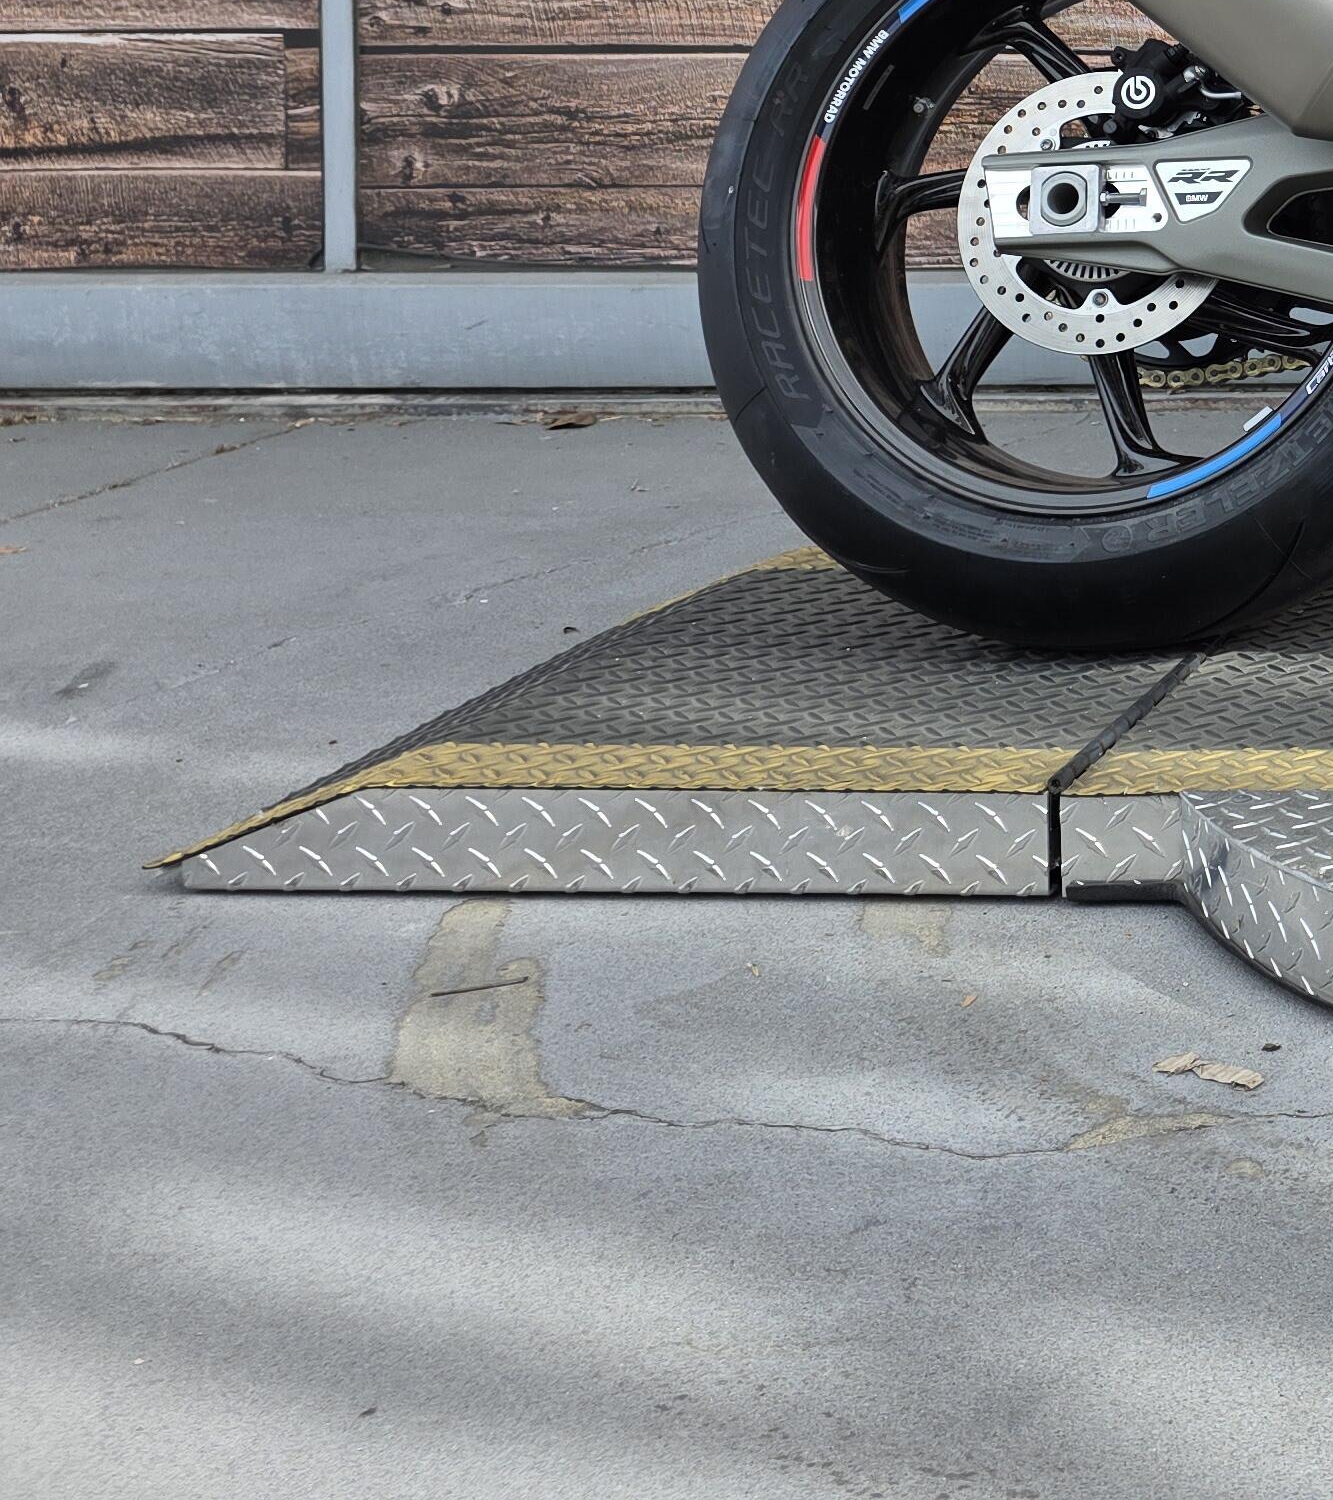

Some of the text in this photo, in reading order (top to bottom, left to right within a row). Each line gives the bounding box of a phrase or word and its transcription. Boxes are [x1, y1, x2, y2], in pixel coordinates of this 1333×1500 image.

[823, 28, 890, 124] BMW MOTORRAD
[1168, 169, 1240, 184] RR
[743, 159, 810, 402] RACETEC
